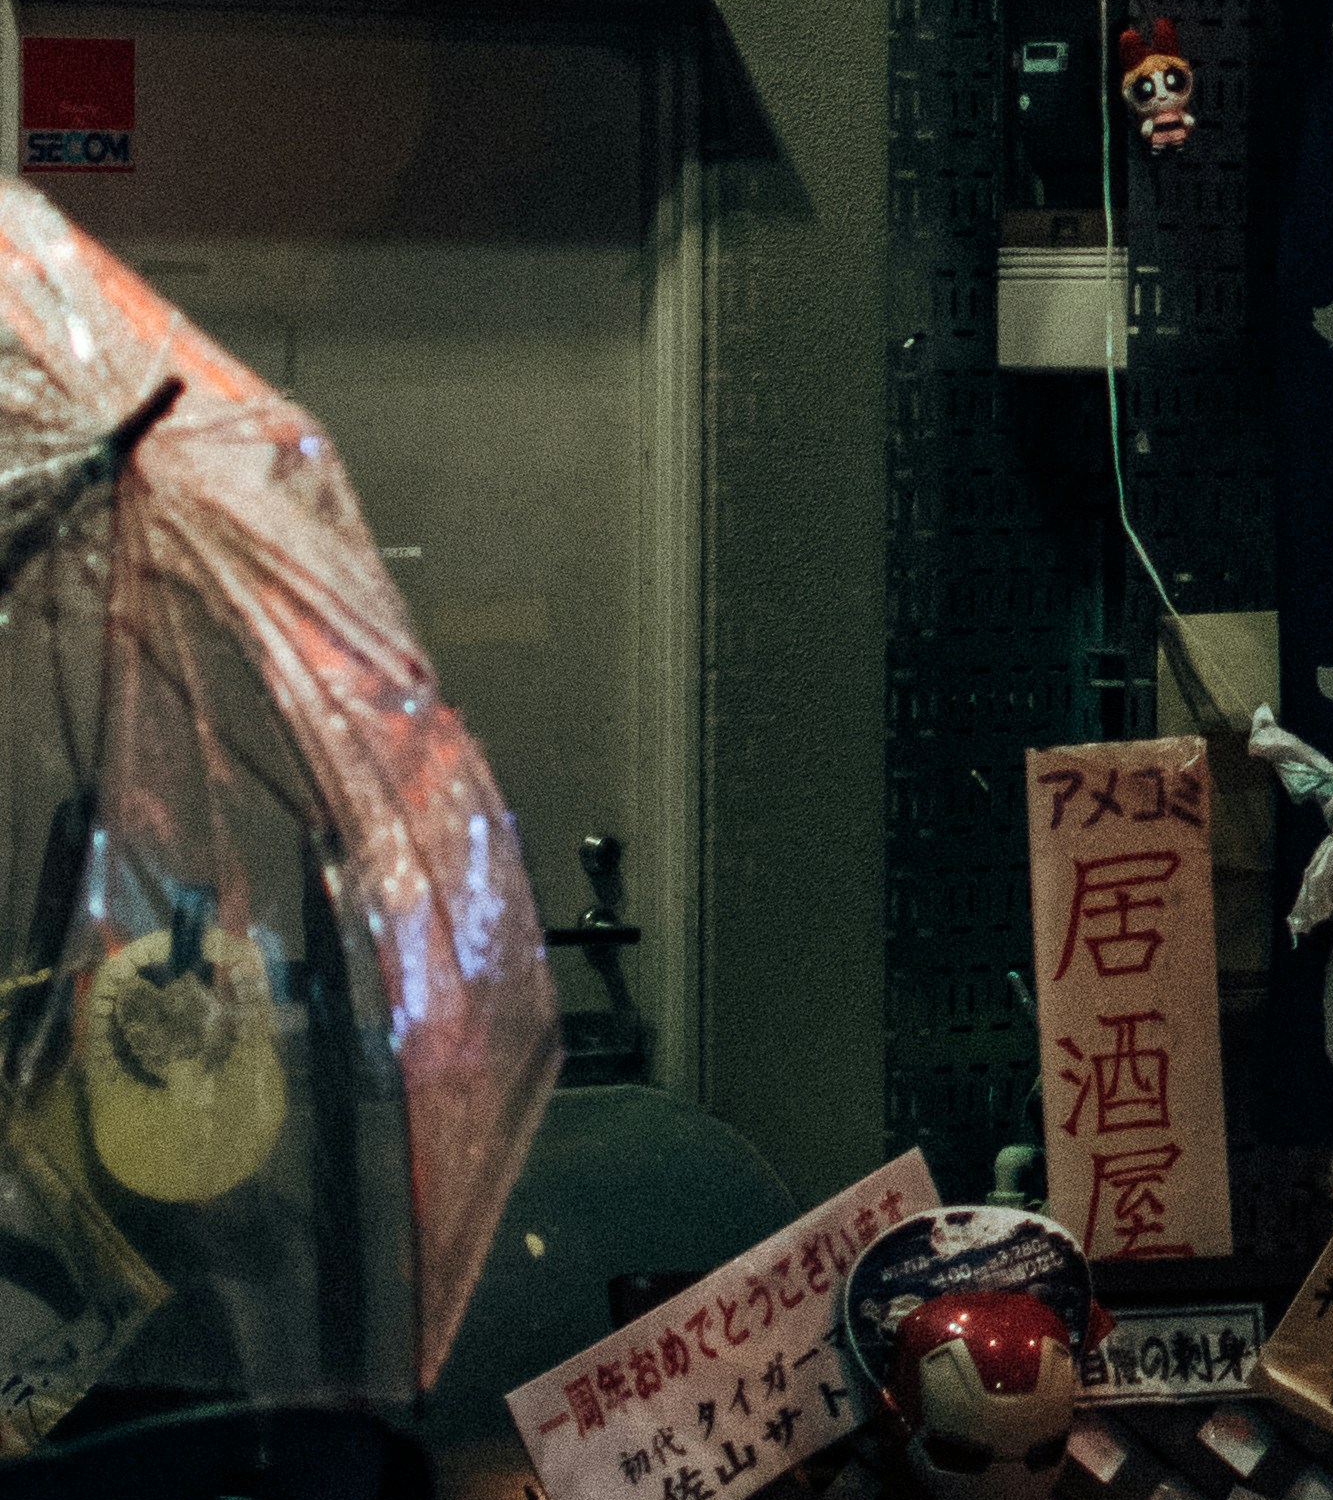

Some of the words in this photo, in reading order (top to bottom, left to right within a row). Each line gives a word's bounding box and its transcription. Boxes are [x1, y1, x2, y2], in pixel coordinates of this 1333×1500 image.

[28, 131, 130, 163] SECOM
[1038, 769, 1204, 830] アメコミ
[1052, 850, 1195, 1259] 居酒屋
